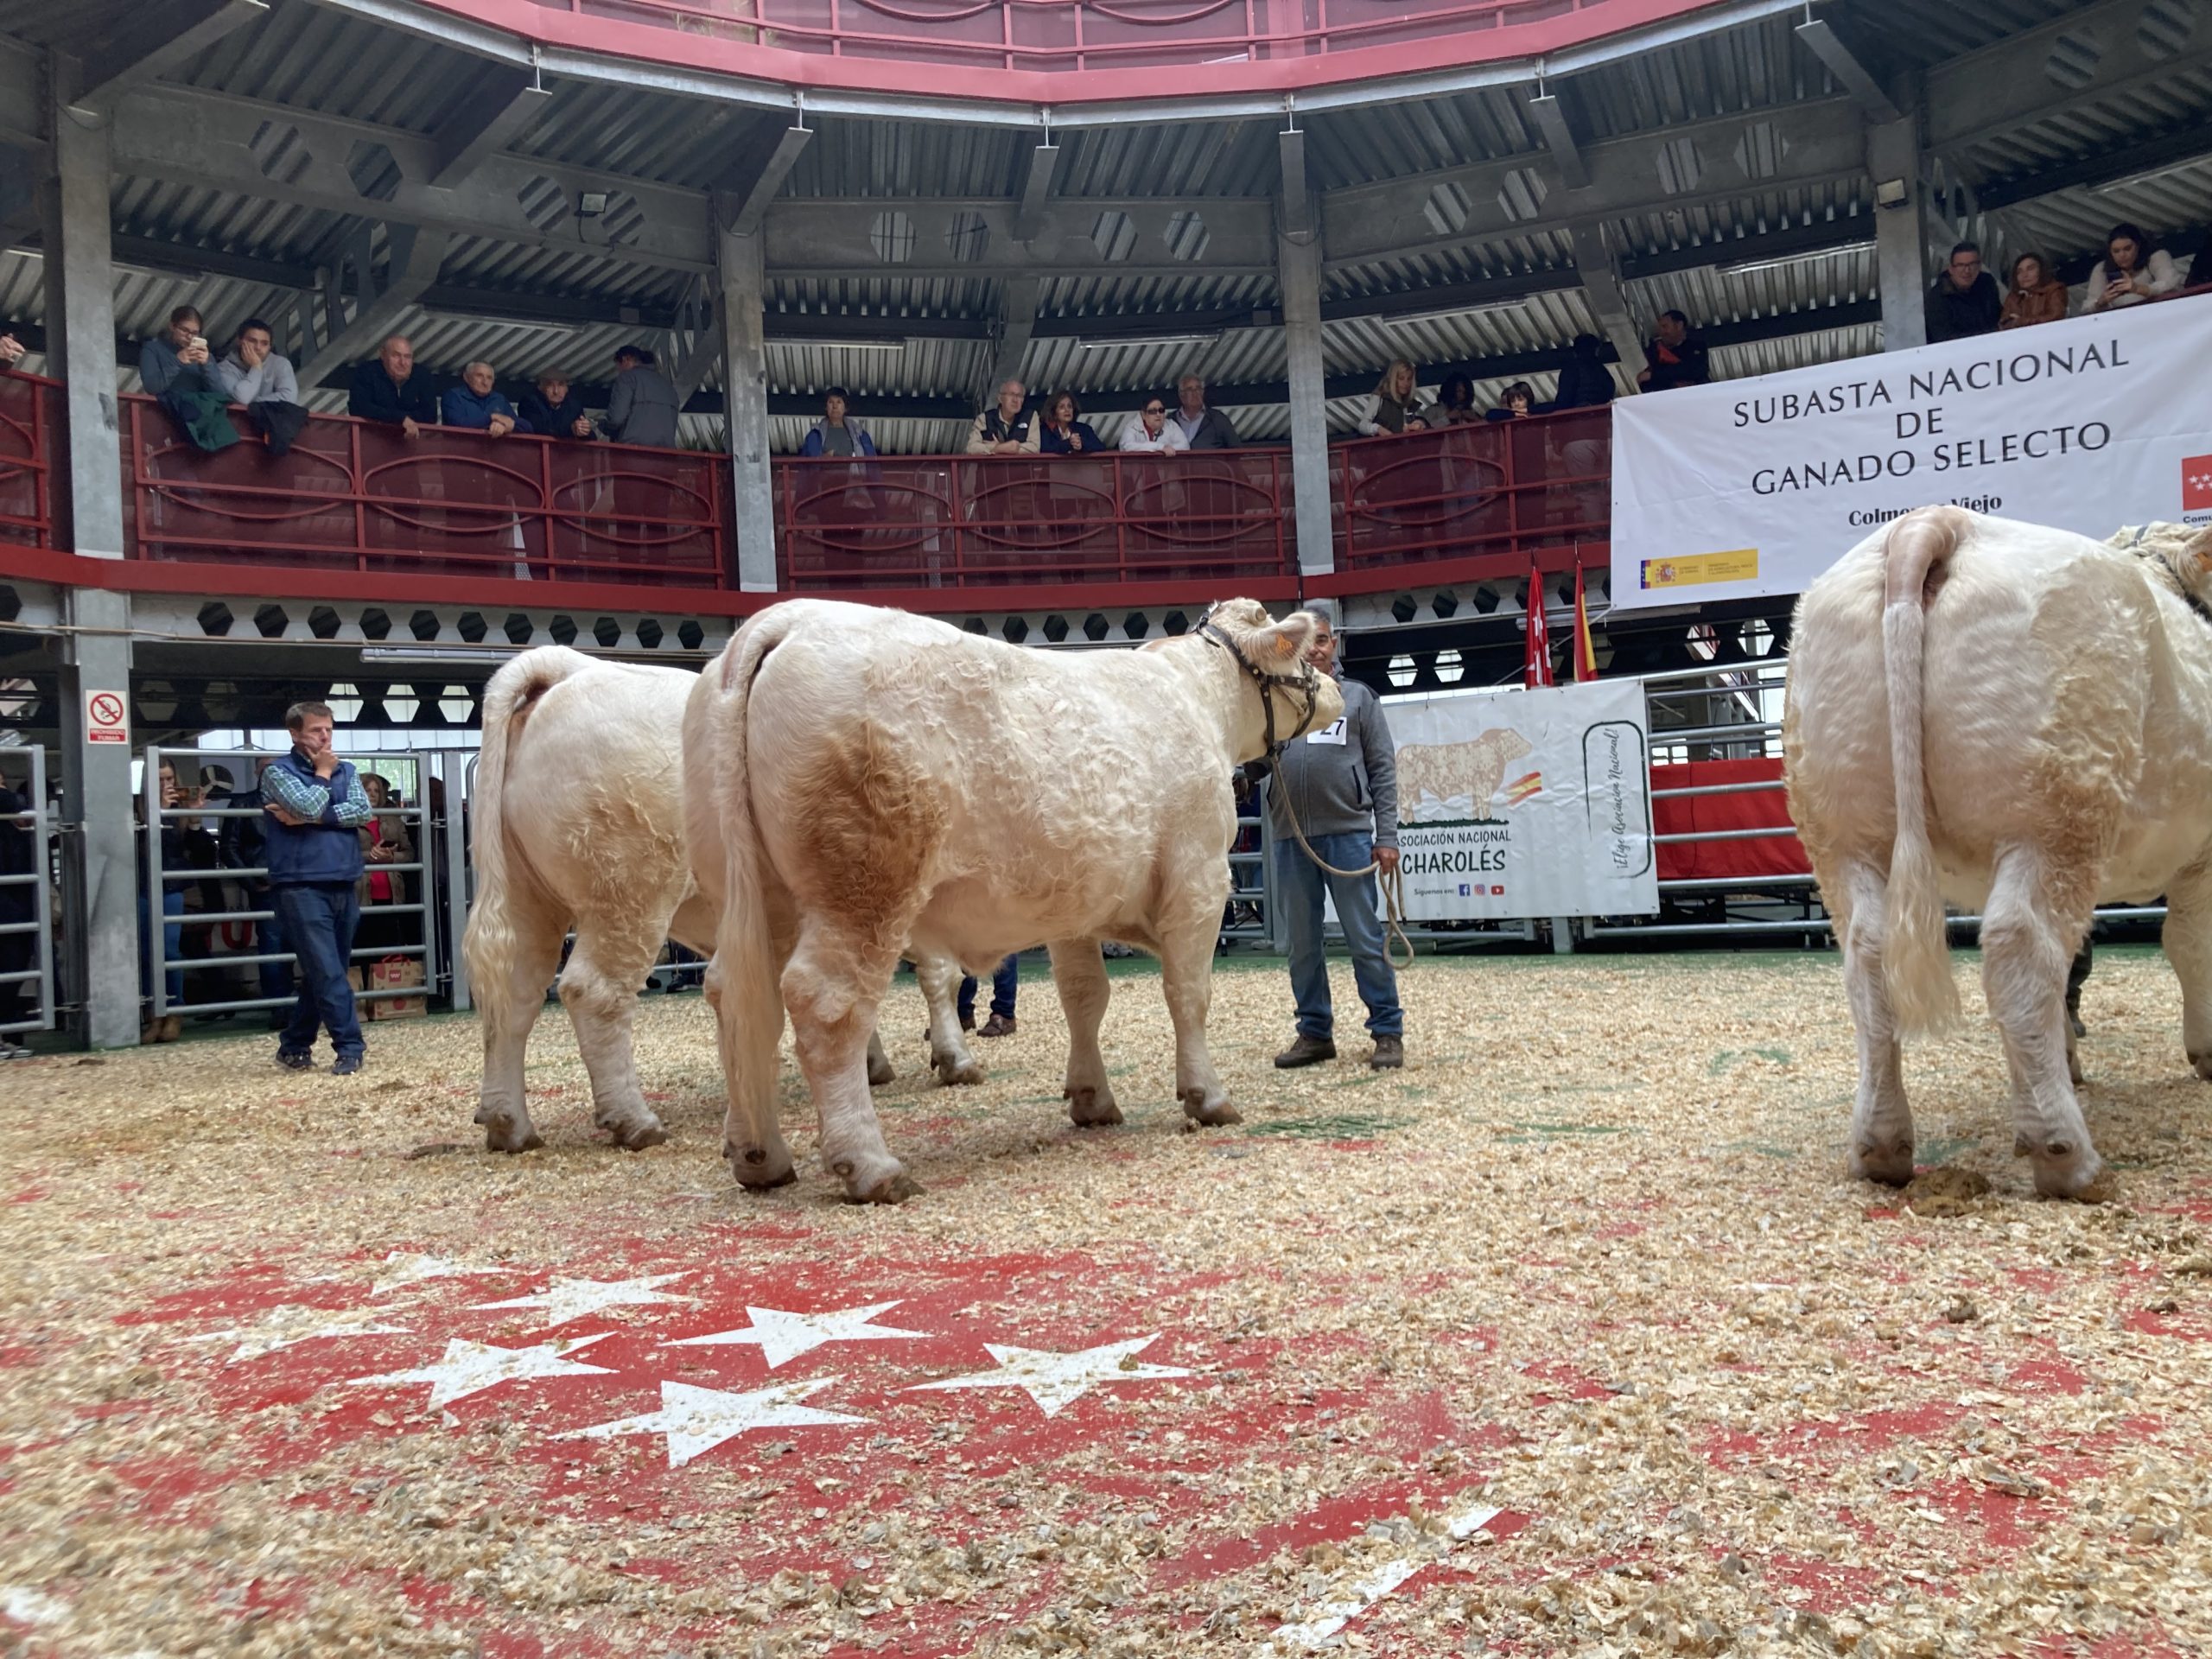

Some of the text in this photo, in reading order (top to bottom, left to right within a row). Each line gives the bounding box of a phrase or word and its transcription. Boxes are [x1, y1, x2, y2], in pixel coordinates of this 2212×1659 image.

[1733, 339, 2130, 428] SUBASTA NACIONAL
[1896, 408, 1944, 439] DE
[1751, 422, 2111, 495] GANADO SELECTO
[1848, 503, 1946, 527] Colme
[1459, 830, 1511, 843] NACIONAL
[1402, 843, 1506, 874] CHAROLÉS
